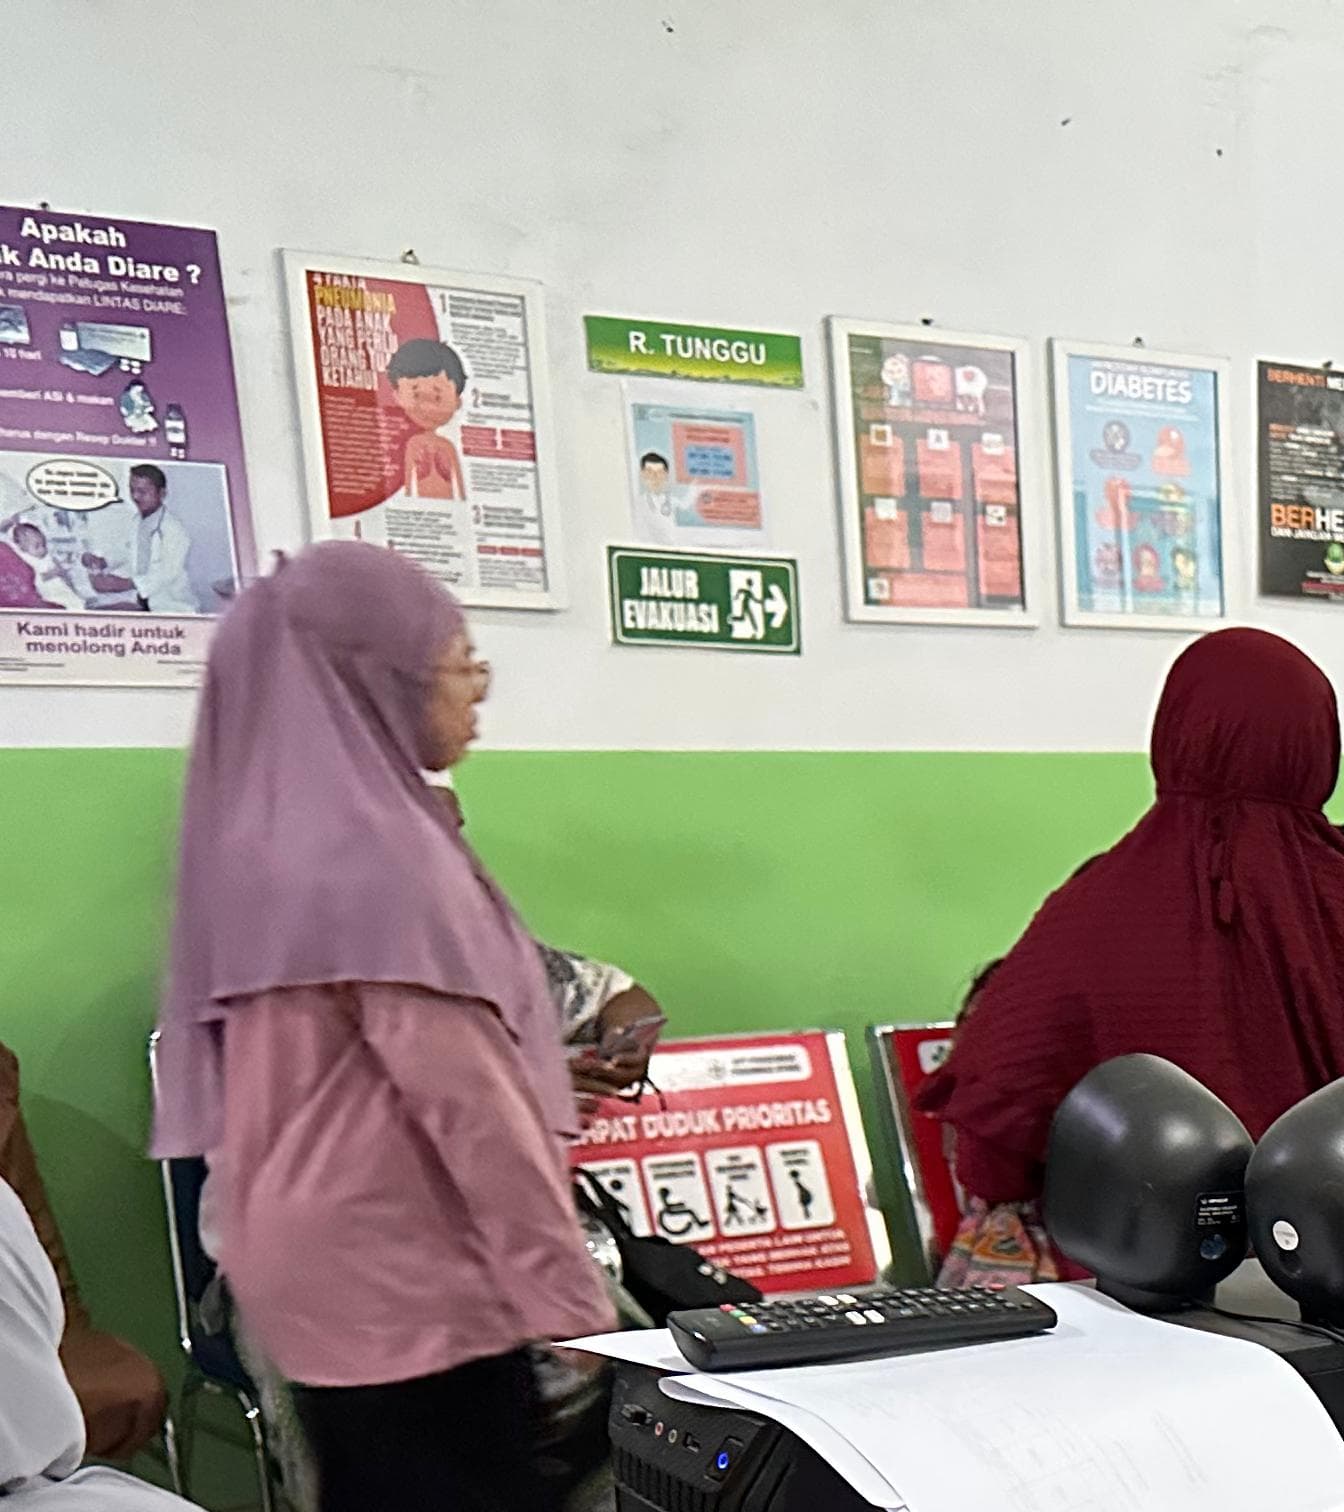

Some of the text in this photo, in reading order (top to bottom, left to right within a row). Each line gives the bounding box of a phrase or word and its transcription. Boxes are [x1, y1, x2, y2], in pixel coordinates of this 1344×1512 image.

[21, 217, 126, 248] Apakah
[0, 245, 201, 284] k Anda Diare ?
[628, 331, 766, 365] R. TUNGGU
[1090, 369, 1192, 404] DIABETES
[640, 567, 699, 599] JALUR
[17, 622, 185, 639] Kami hadir untuk
[623, 600, 720, 633] EVAKUASI
[26, 640, 182, 657] menolong Anda
[641, 1109, 721, 1138] DUDUK
[723, 1099, 832, 1131] PRIORITAS
